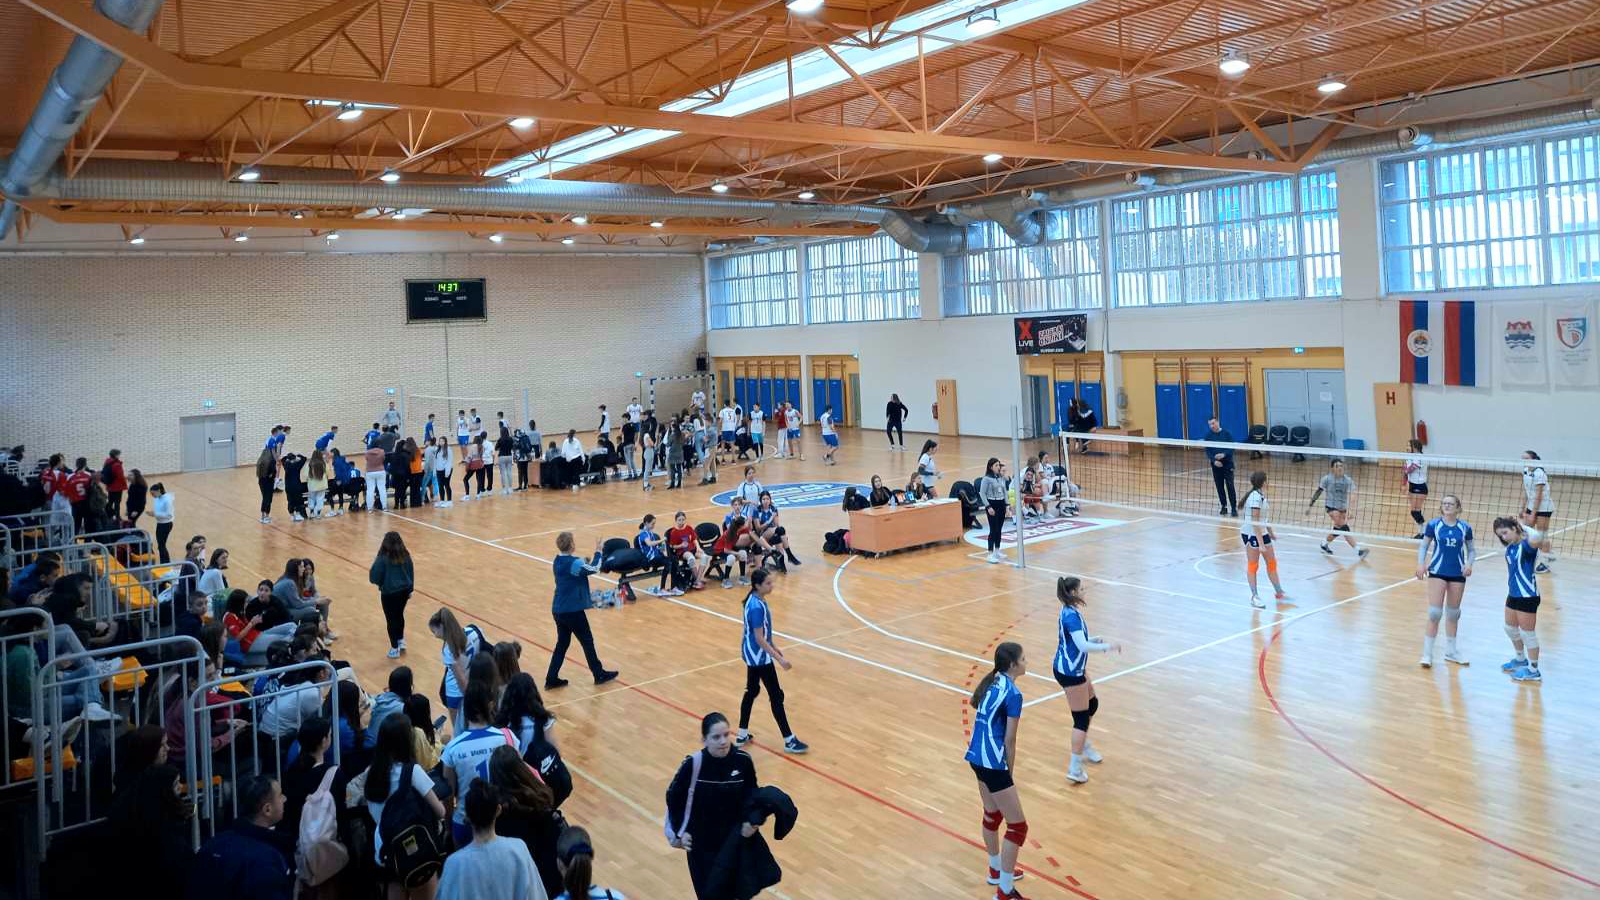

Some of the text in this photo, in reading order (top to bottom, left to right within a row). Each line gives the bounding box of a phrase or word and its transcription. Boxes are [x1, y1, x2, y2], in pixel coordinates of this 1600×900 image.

[1018, 321, 1033, 340] X
[1386, 391, 1396, 405] H
[1445, 537, 1457, 547] 12
